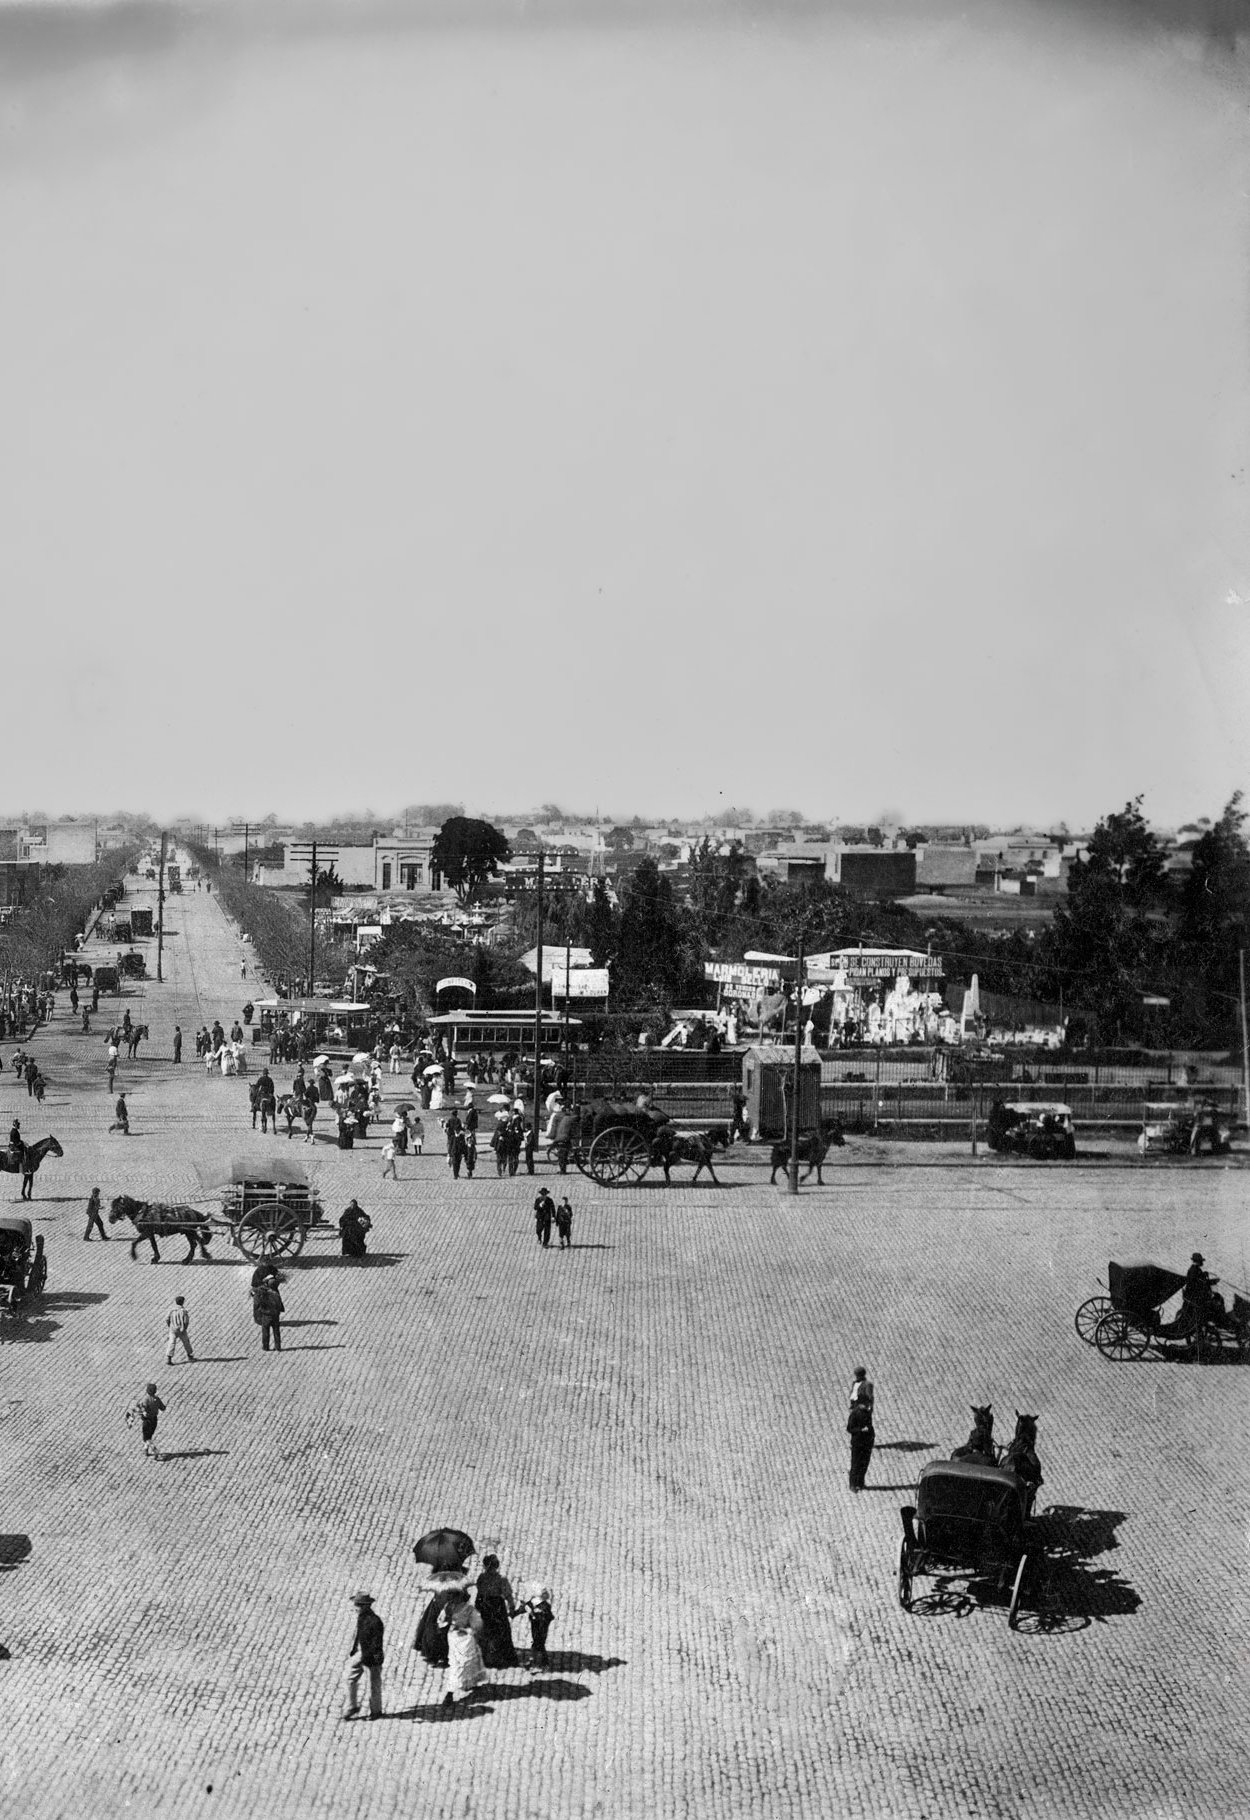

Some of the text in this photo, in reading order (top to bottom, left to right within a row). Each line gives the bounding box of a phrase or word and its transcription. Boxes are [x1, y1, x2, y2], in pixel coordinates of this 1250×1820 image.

[850, 956, 859, 968] SE
[861, 956, 908, 968] CONSTRUYEN
[909, 956, 943, 968] BOVEDAS
[704, 962, 780, 981] MARMOLERIA
[848, 967, 943, 977] PIDAN PLANOS Y PRESUPUESTOS
